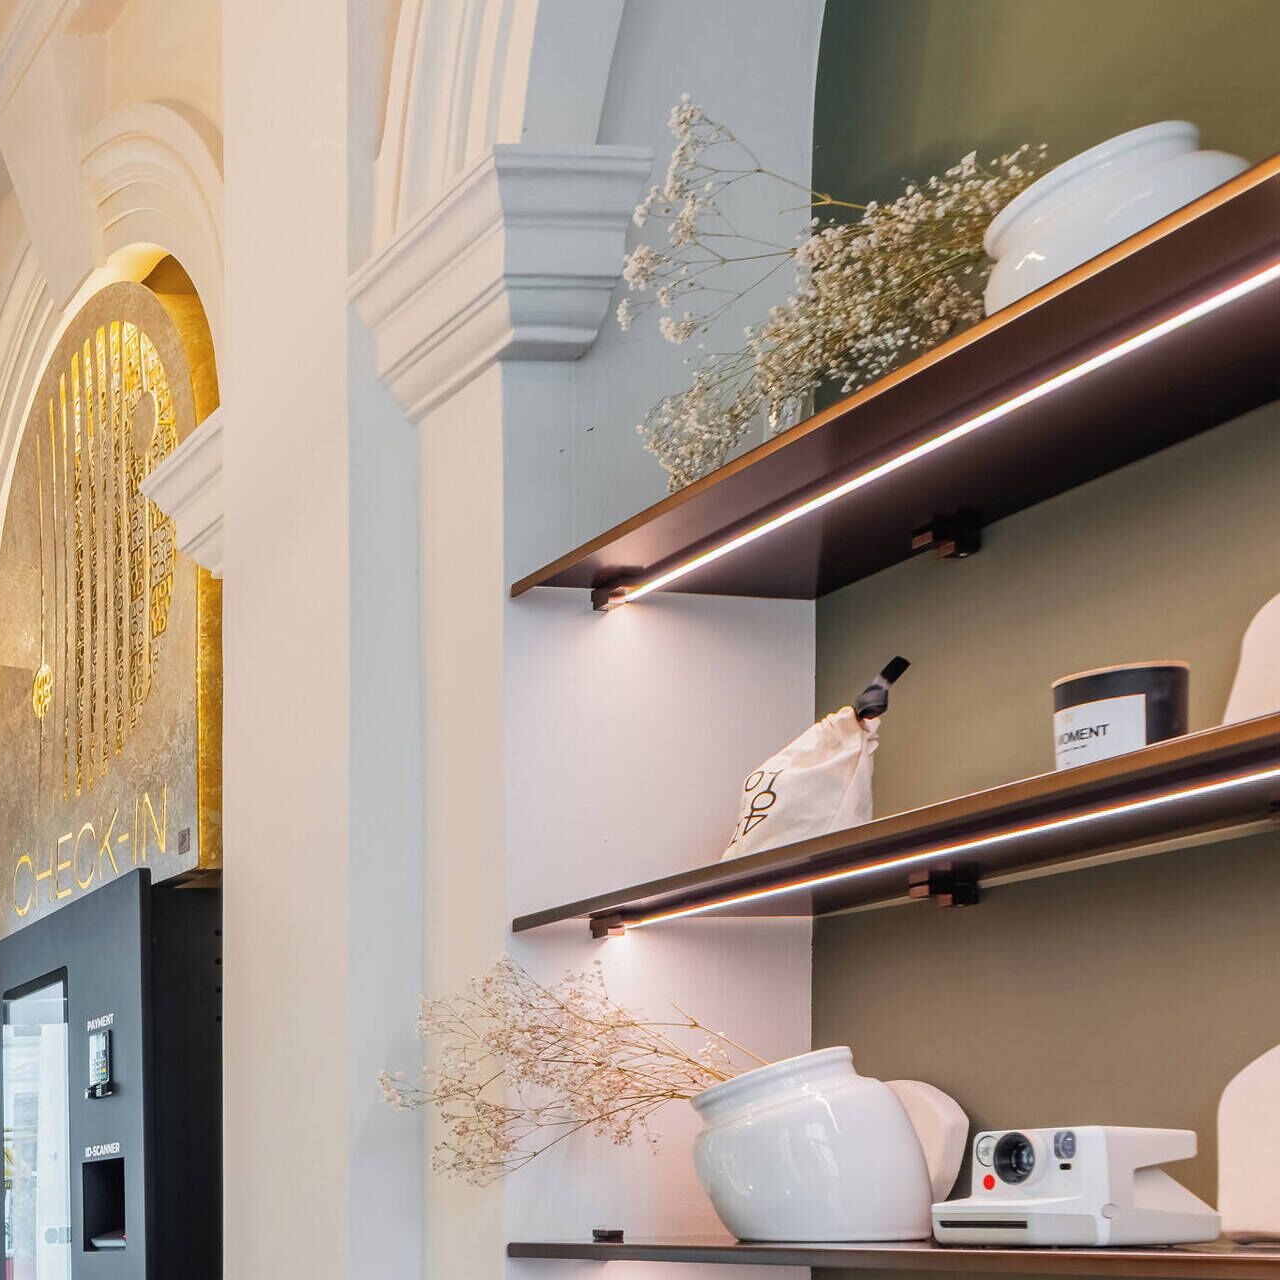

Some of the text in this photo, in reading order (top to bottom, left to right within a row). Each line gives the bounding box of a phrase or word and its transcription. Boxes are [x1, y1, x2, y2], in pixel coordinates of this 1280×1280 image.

[13, 783, 167, 917] CHECK-IN
[87, 1013, 114, 1032] PAYMENT
[85, 1142, 120, 1158] ID-SCANNER
